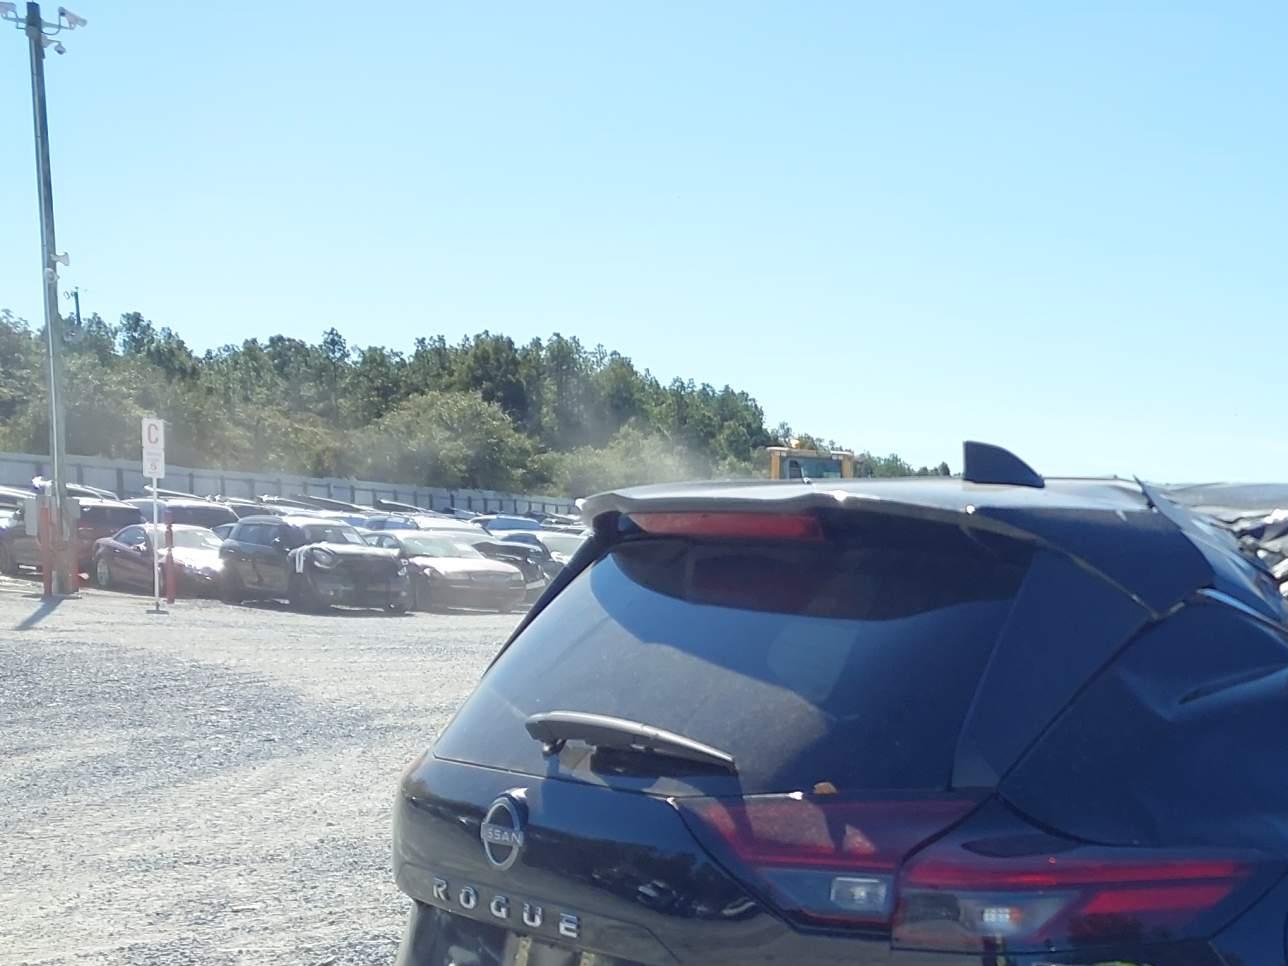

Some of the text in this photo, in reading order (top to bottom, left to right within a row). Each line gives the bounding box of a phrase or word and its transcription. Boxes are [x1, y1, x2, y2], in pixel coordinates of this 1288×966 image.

[147, 423, 159, 444] C
[481, 823, 524, 847] SSAN
[432, 876, 578, 938] ROGUE
